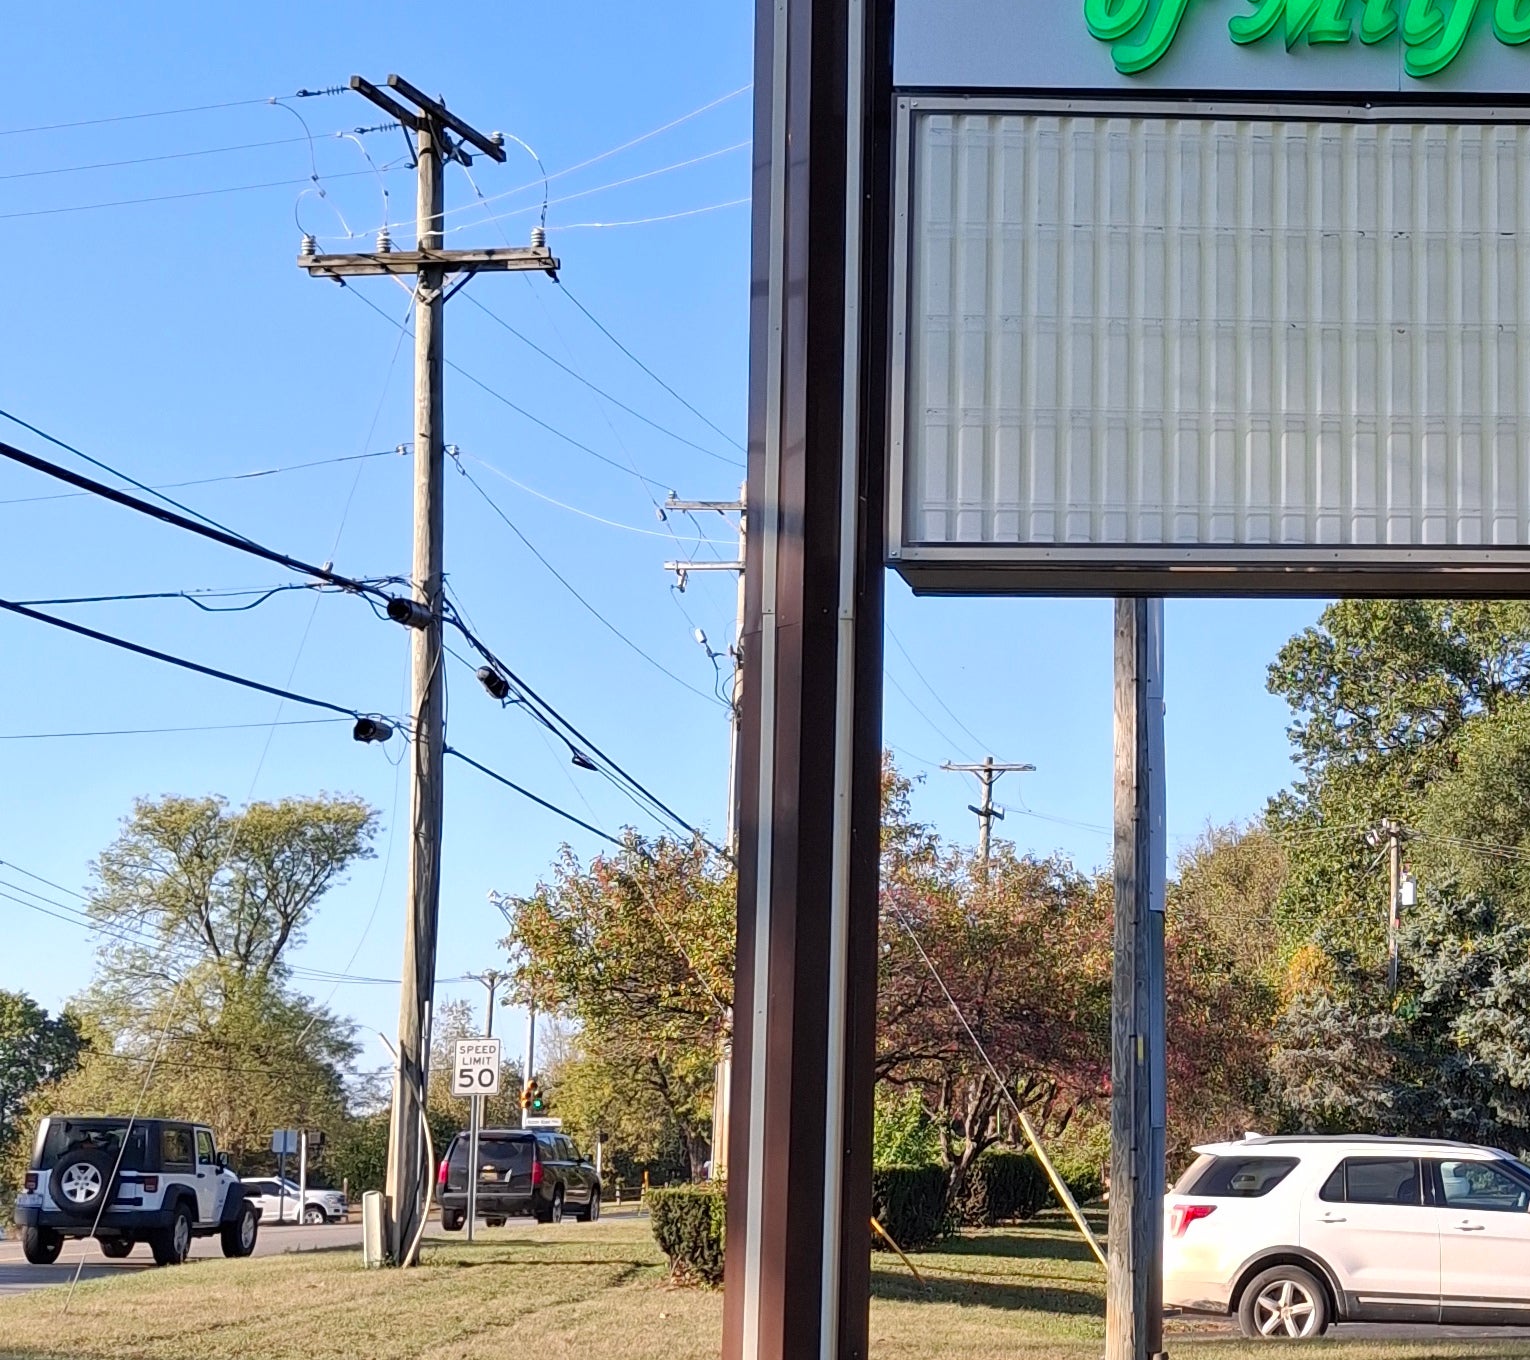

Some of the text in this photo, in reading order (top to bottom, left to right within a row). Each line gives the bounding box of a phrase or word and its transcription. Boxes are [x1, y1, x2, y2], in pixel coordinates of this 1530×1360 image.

[459, 1045, 497, 1054] SPEED
[462, 1056, 492, 1066] LIMIT
[458, 1068, 495, 1088] 50
